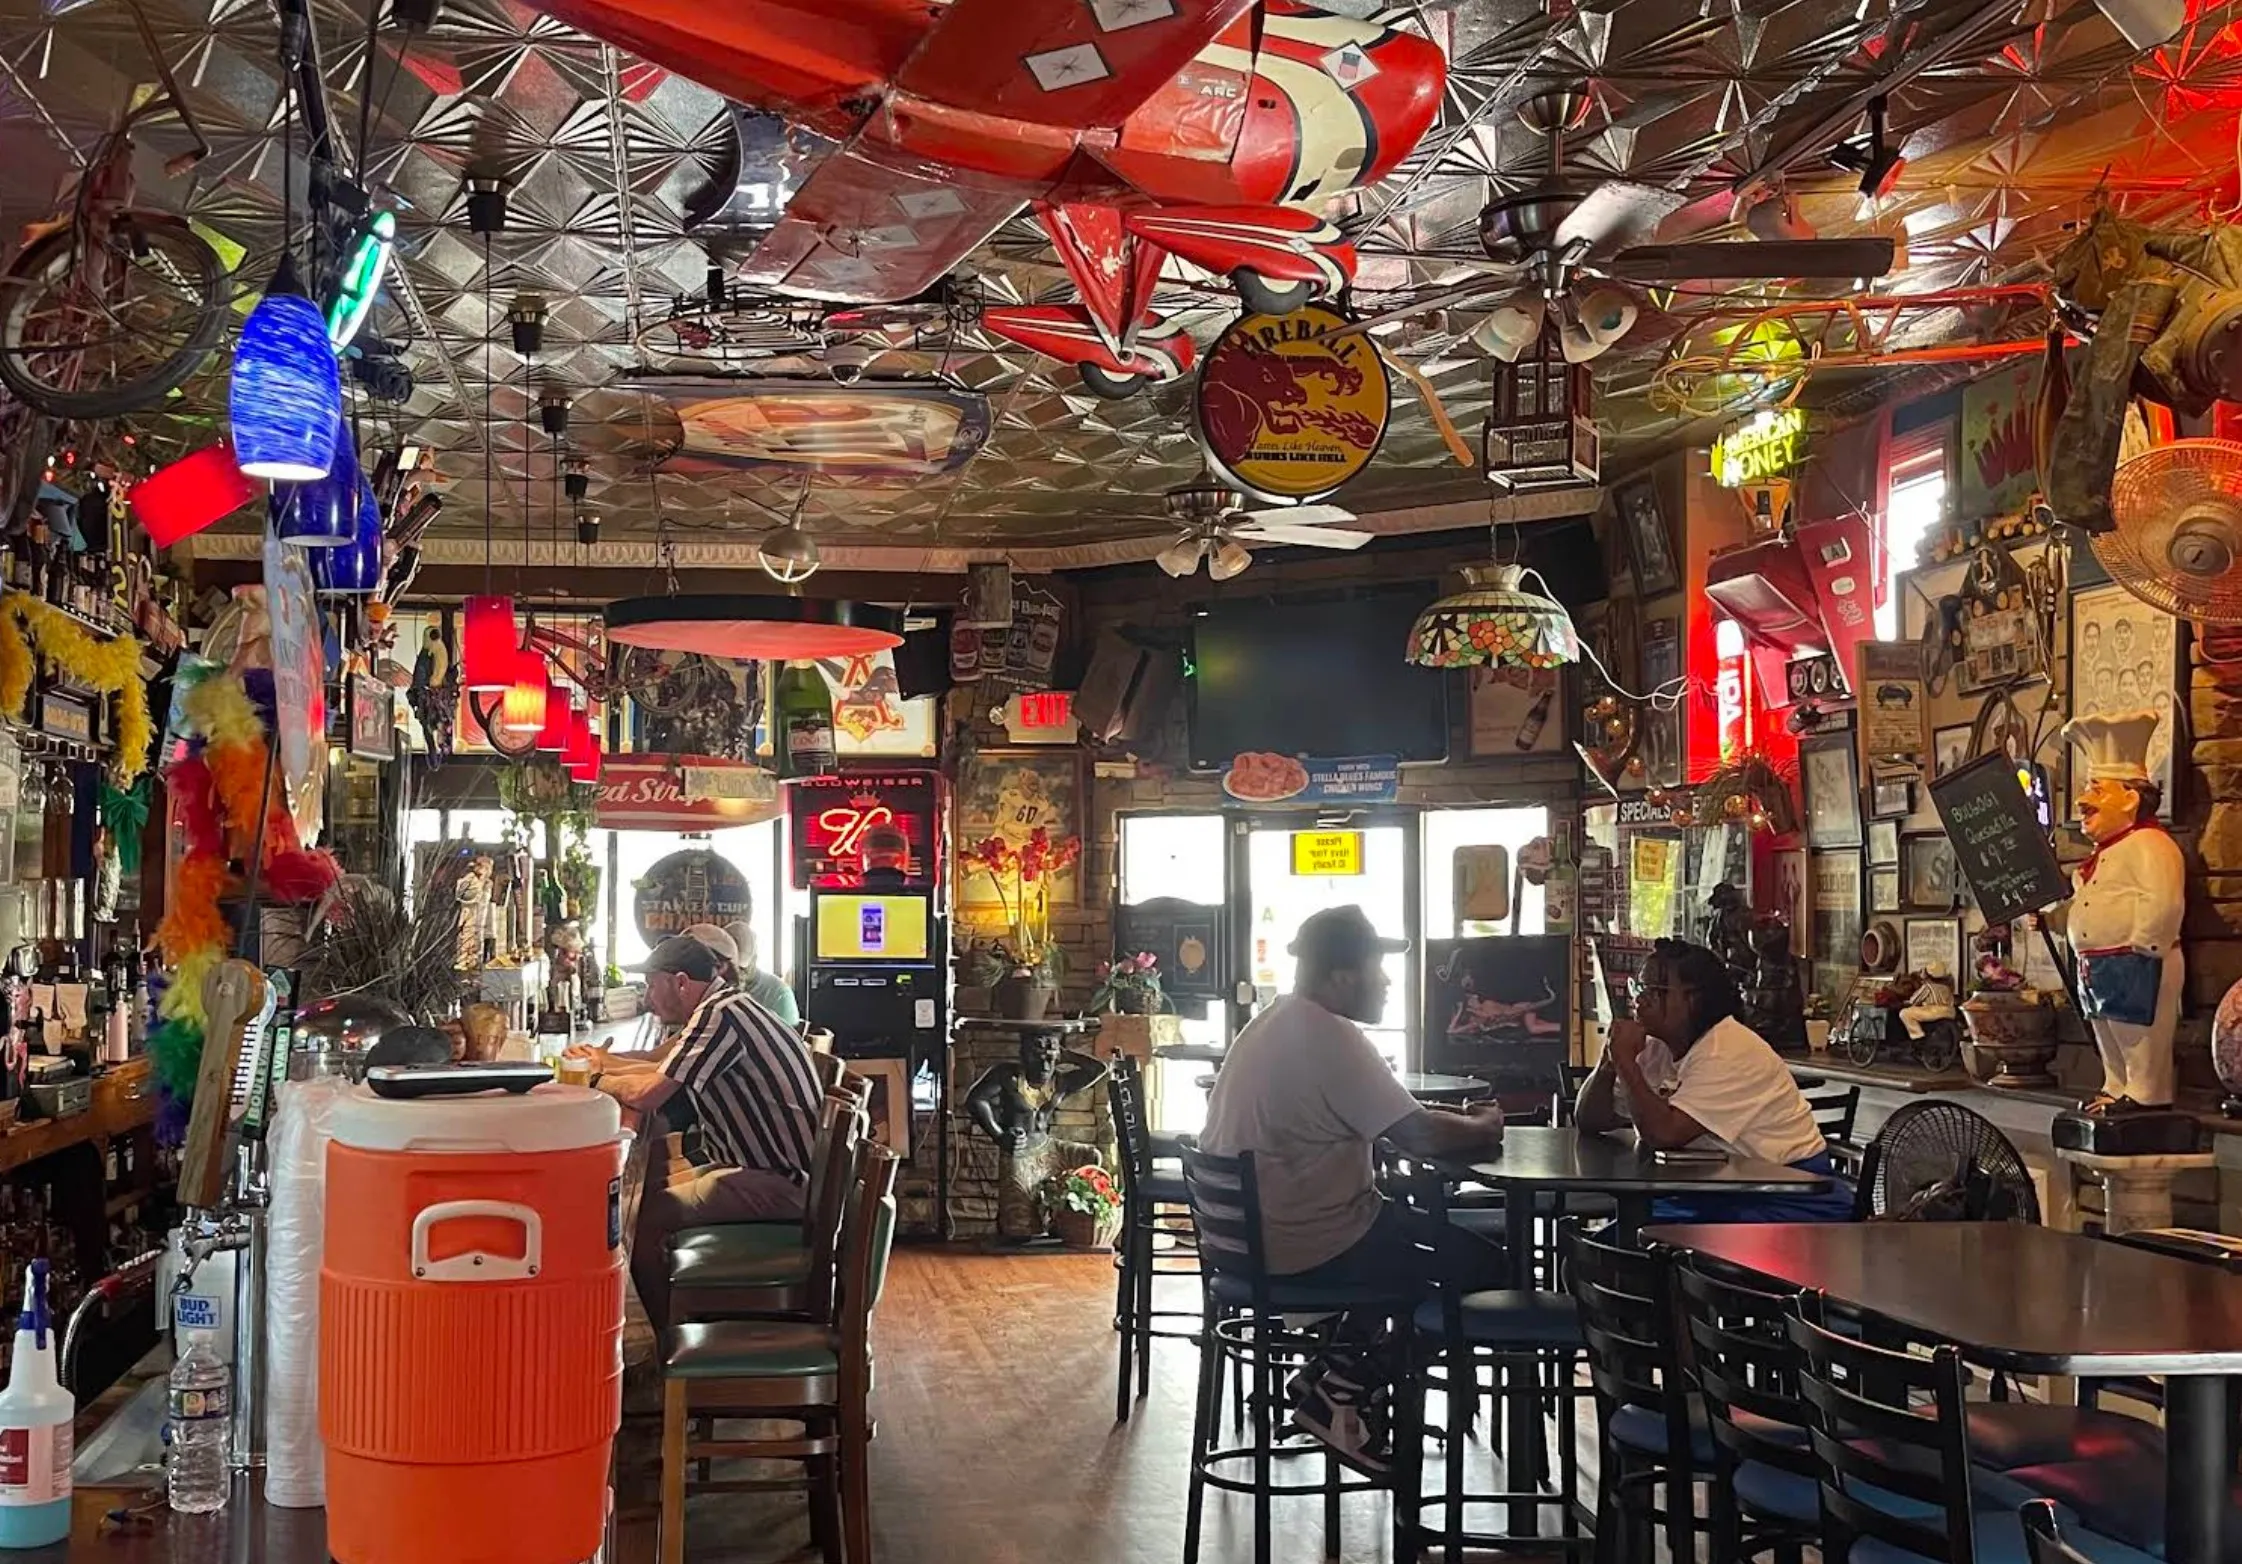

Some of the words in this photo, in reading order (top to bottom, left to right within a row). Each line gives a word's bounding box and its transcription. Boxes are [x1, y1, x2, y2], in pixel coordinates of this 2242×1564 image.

[1200, 86, 1236, 97] ARC
[1722, 408, 1802, 458] AMERICAN
[1722, 435, 1795, 488] HONEY
[1020, 693, 1069, 727] EXIT
[1016, 804, 1038, 824] 60
[1621, 801, 1671, 821] SPECIALS
[179, 1298, 210, 1312] BUD
[177, 1311, 217, 1325] LIGHT
